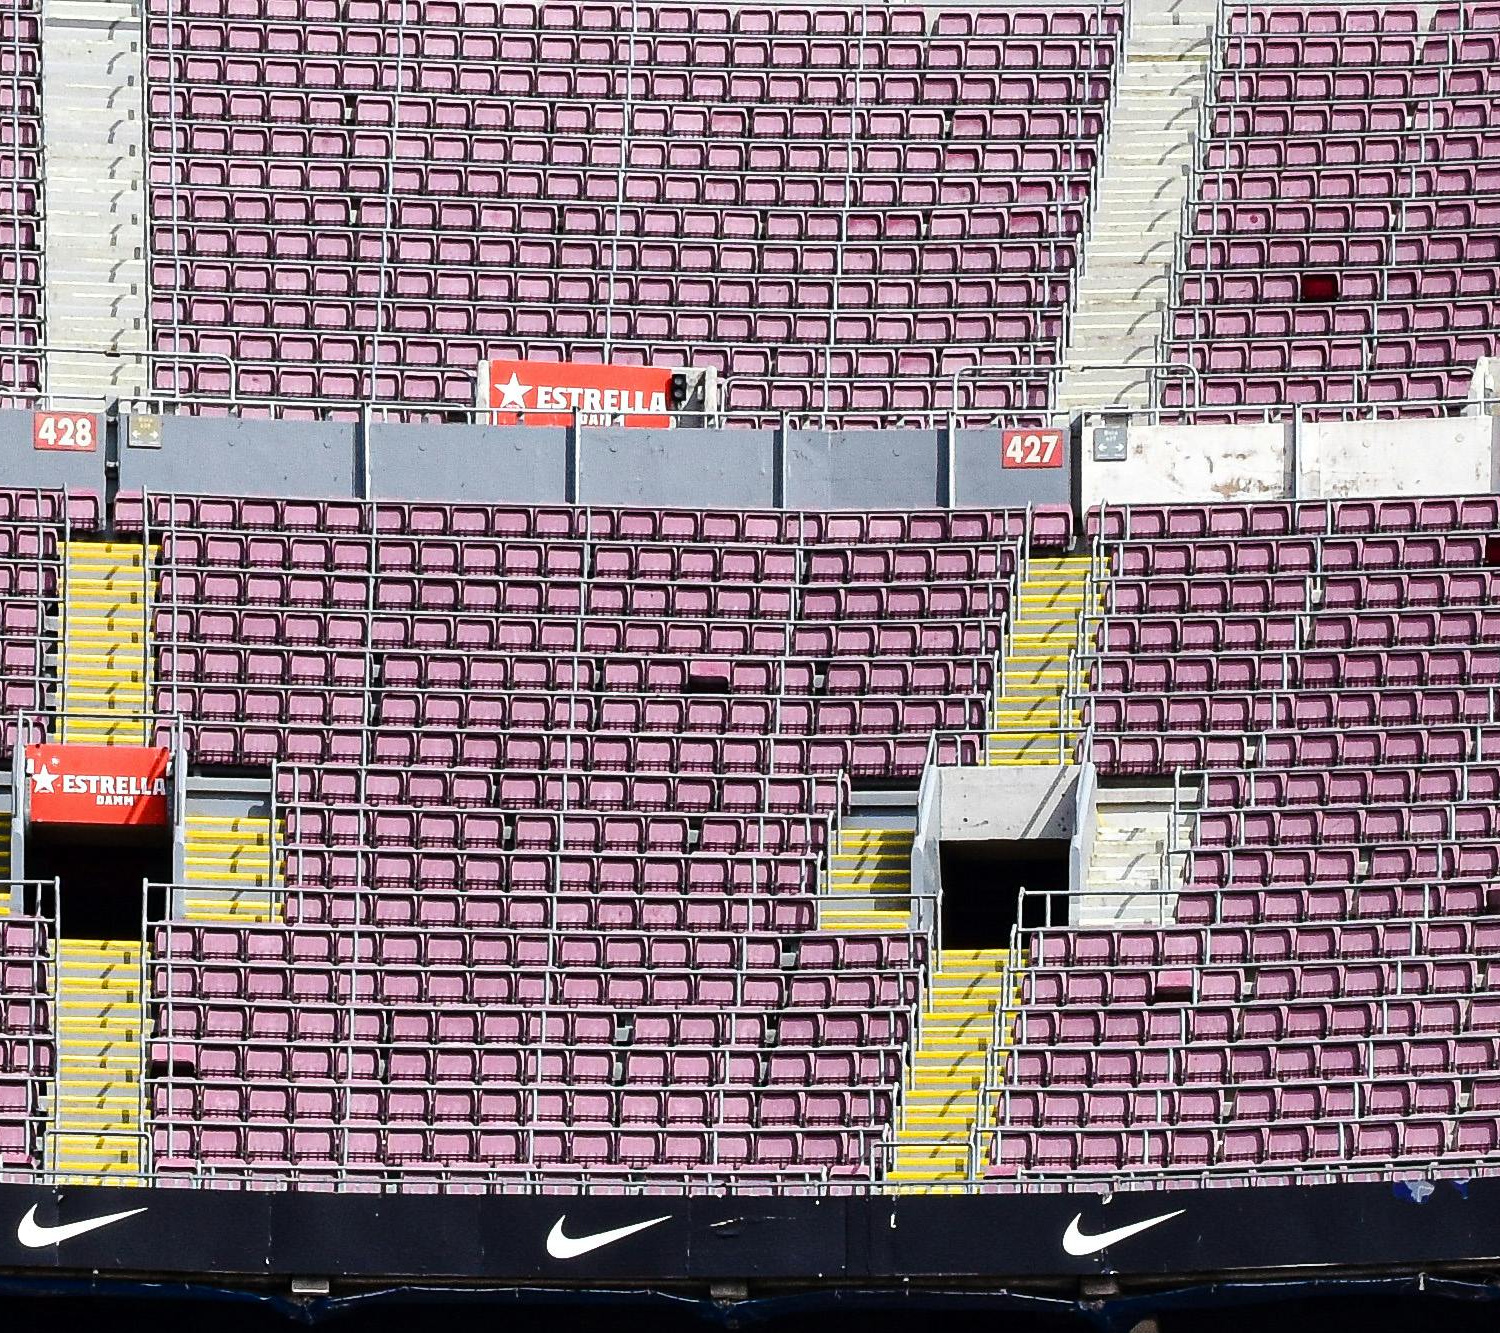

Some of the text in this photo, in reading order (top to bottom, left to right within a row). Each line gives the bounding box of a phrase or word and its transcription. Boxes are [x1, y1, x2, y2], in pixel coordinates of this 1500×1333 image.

[537, 385, 667, 412] ESTRELLA
[38, 417, 92, 447] 428
[1006, 434, 1059, 463] 427
[62, 774, 166, 796] ESTRELLA
[96, 795, 134, 806] DAMM
